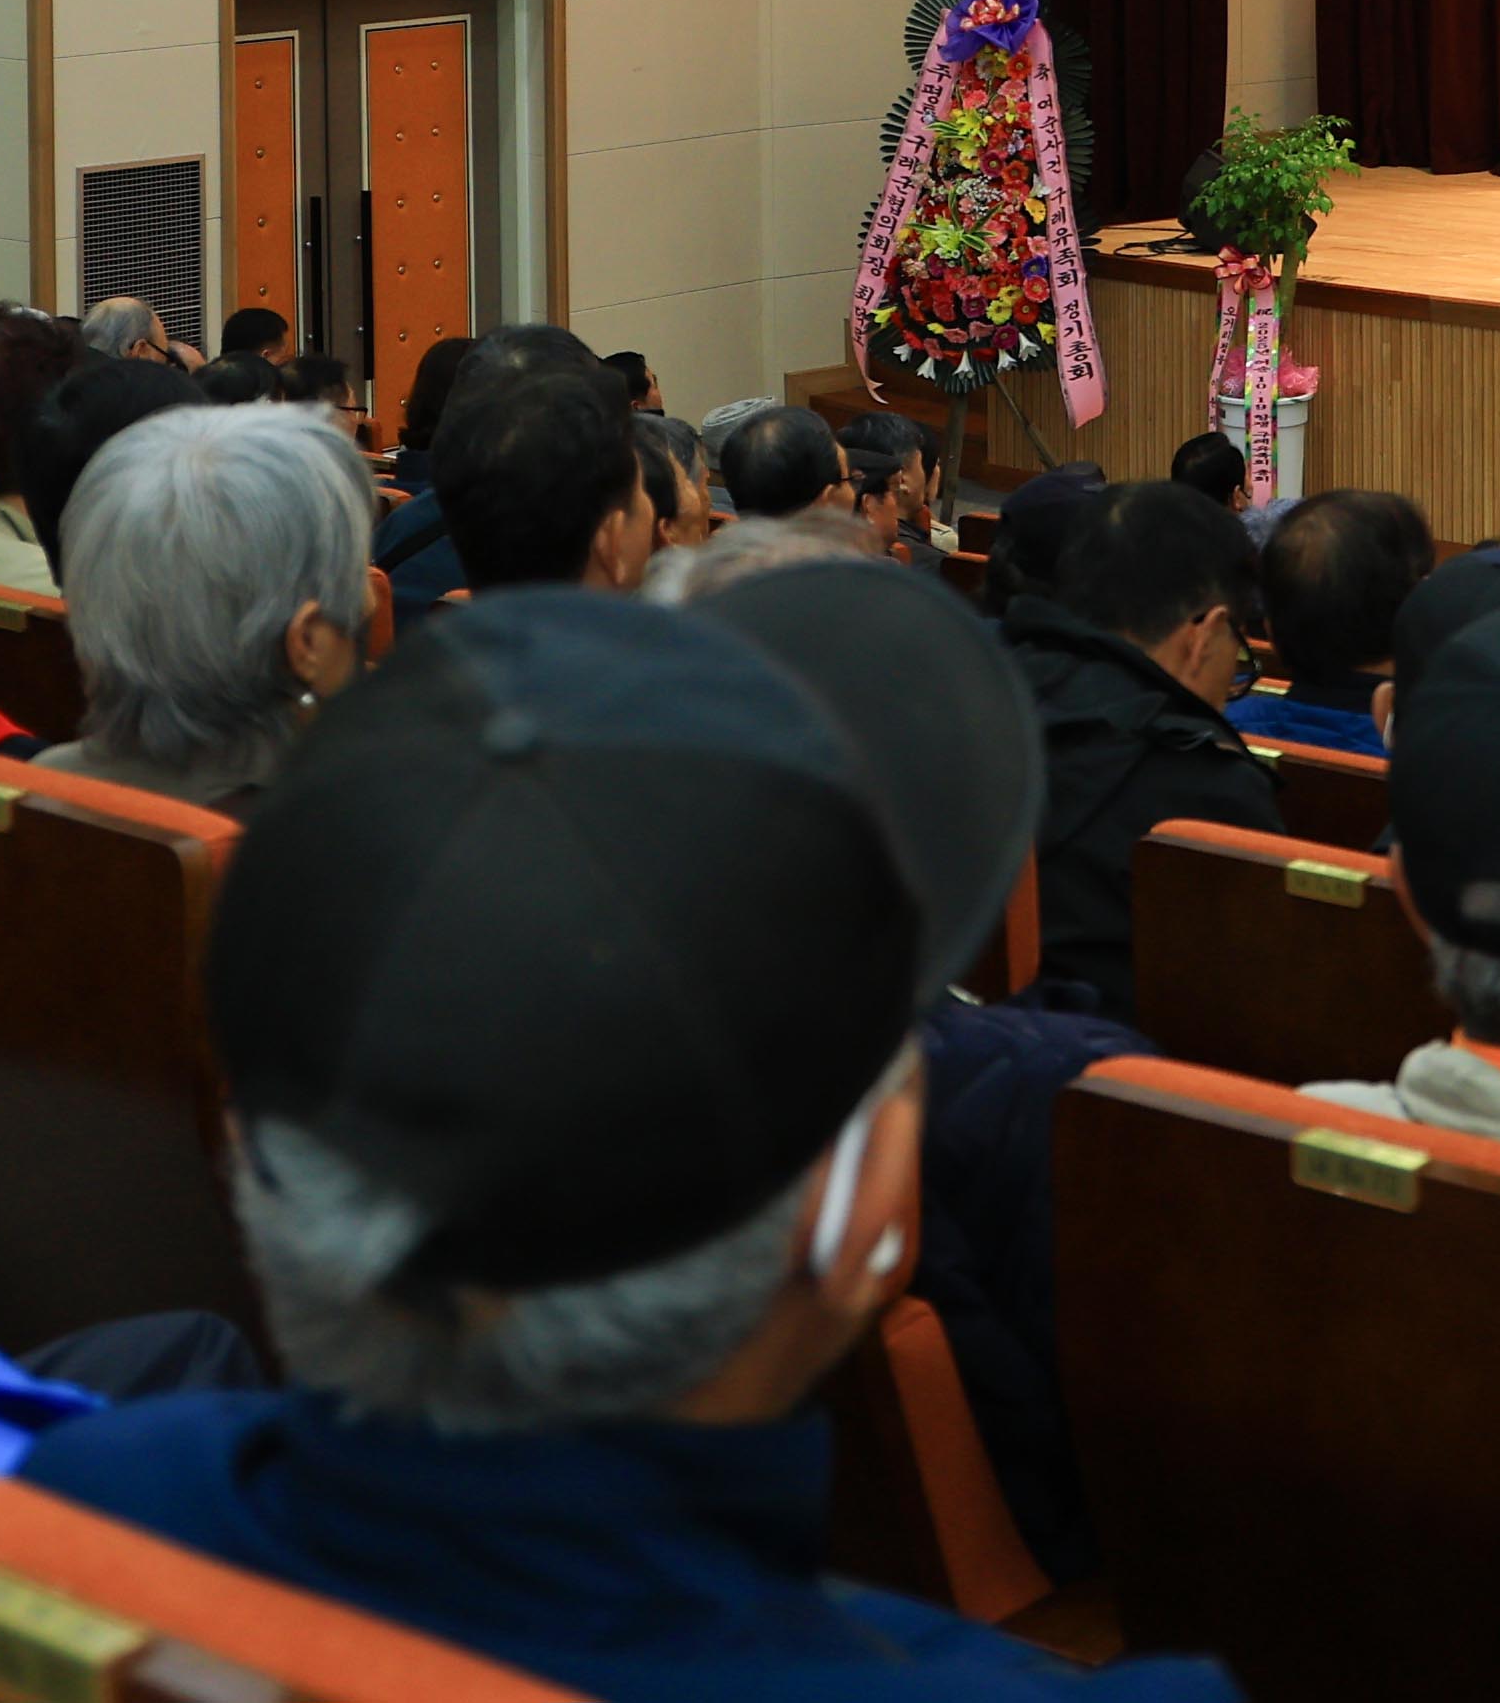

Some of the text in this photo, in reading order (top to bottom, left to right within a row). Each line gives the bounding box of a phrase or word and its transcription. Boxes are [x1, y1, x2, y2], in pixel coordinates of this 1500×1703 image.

[1037, 94, 1063, 174] 여순사건
[1050, 187, 1077, 287] 구례유족회
[1062, 299, 1094, 381] 정기총회
